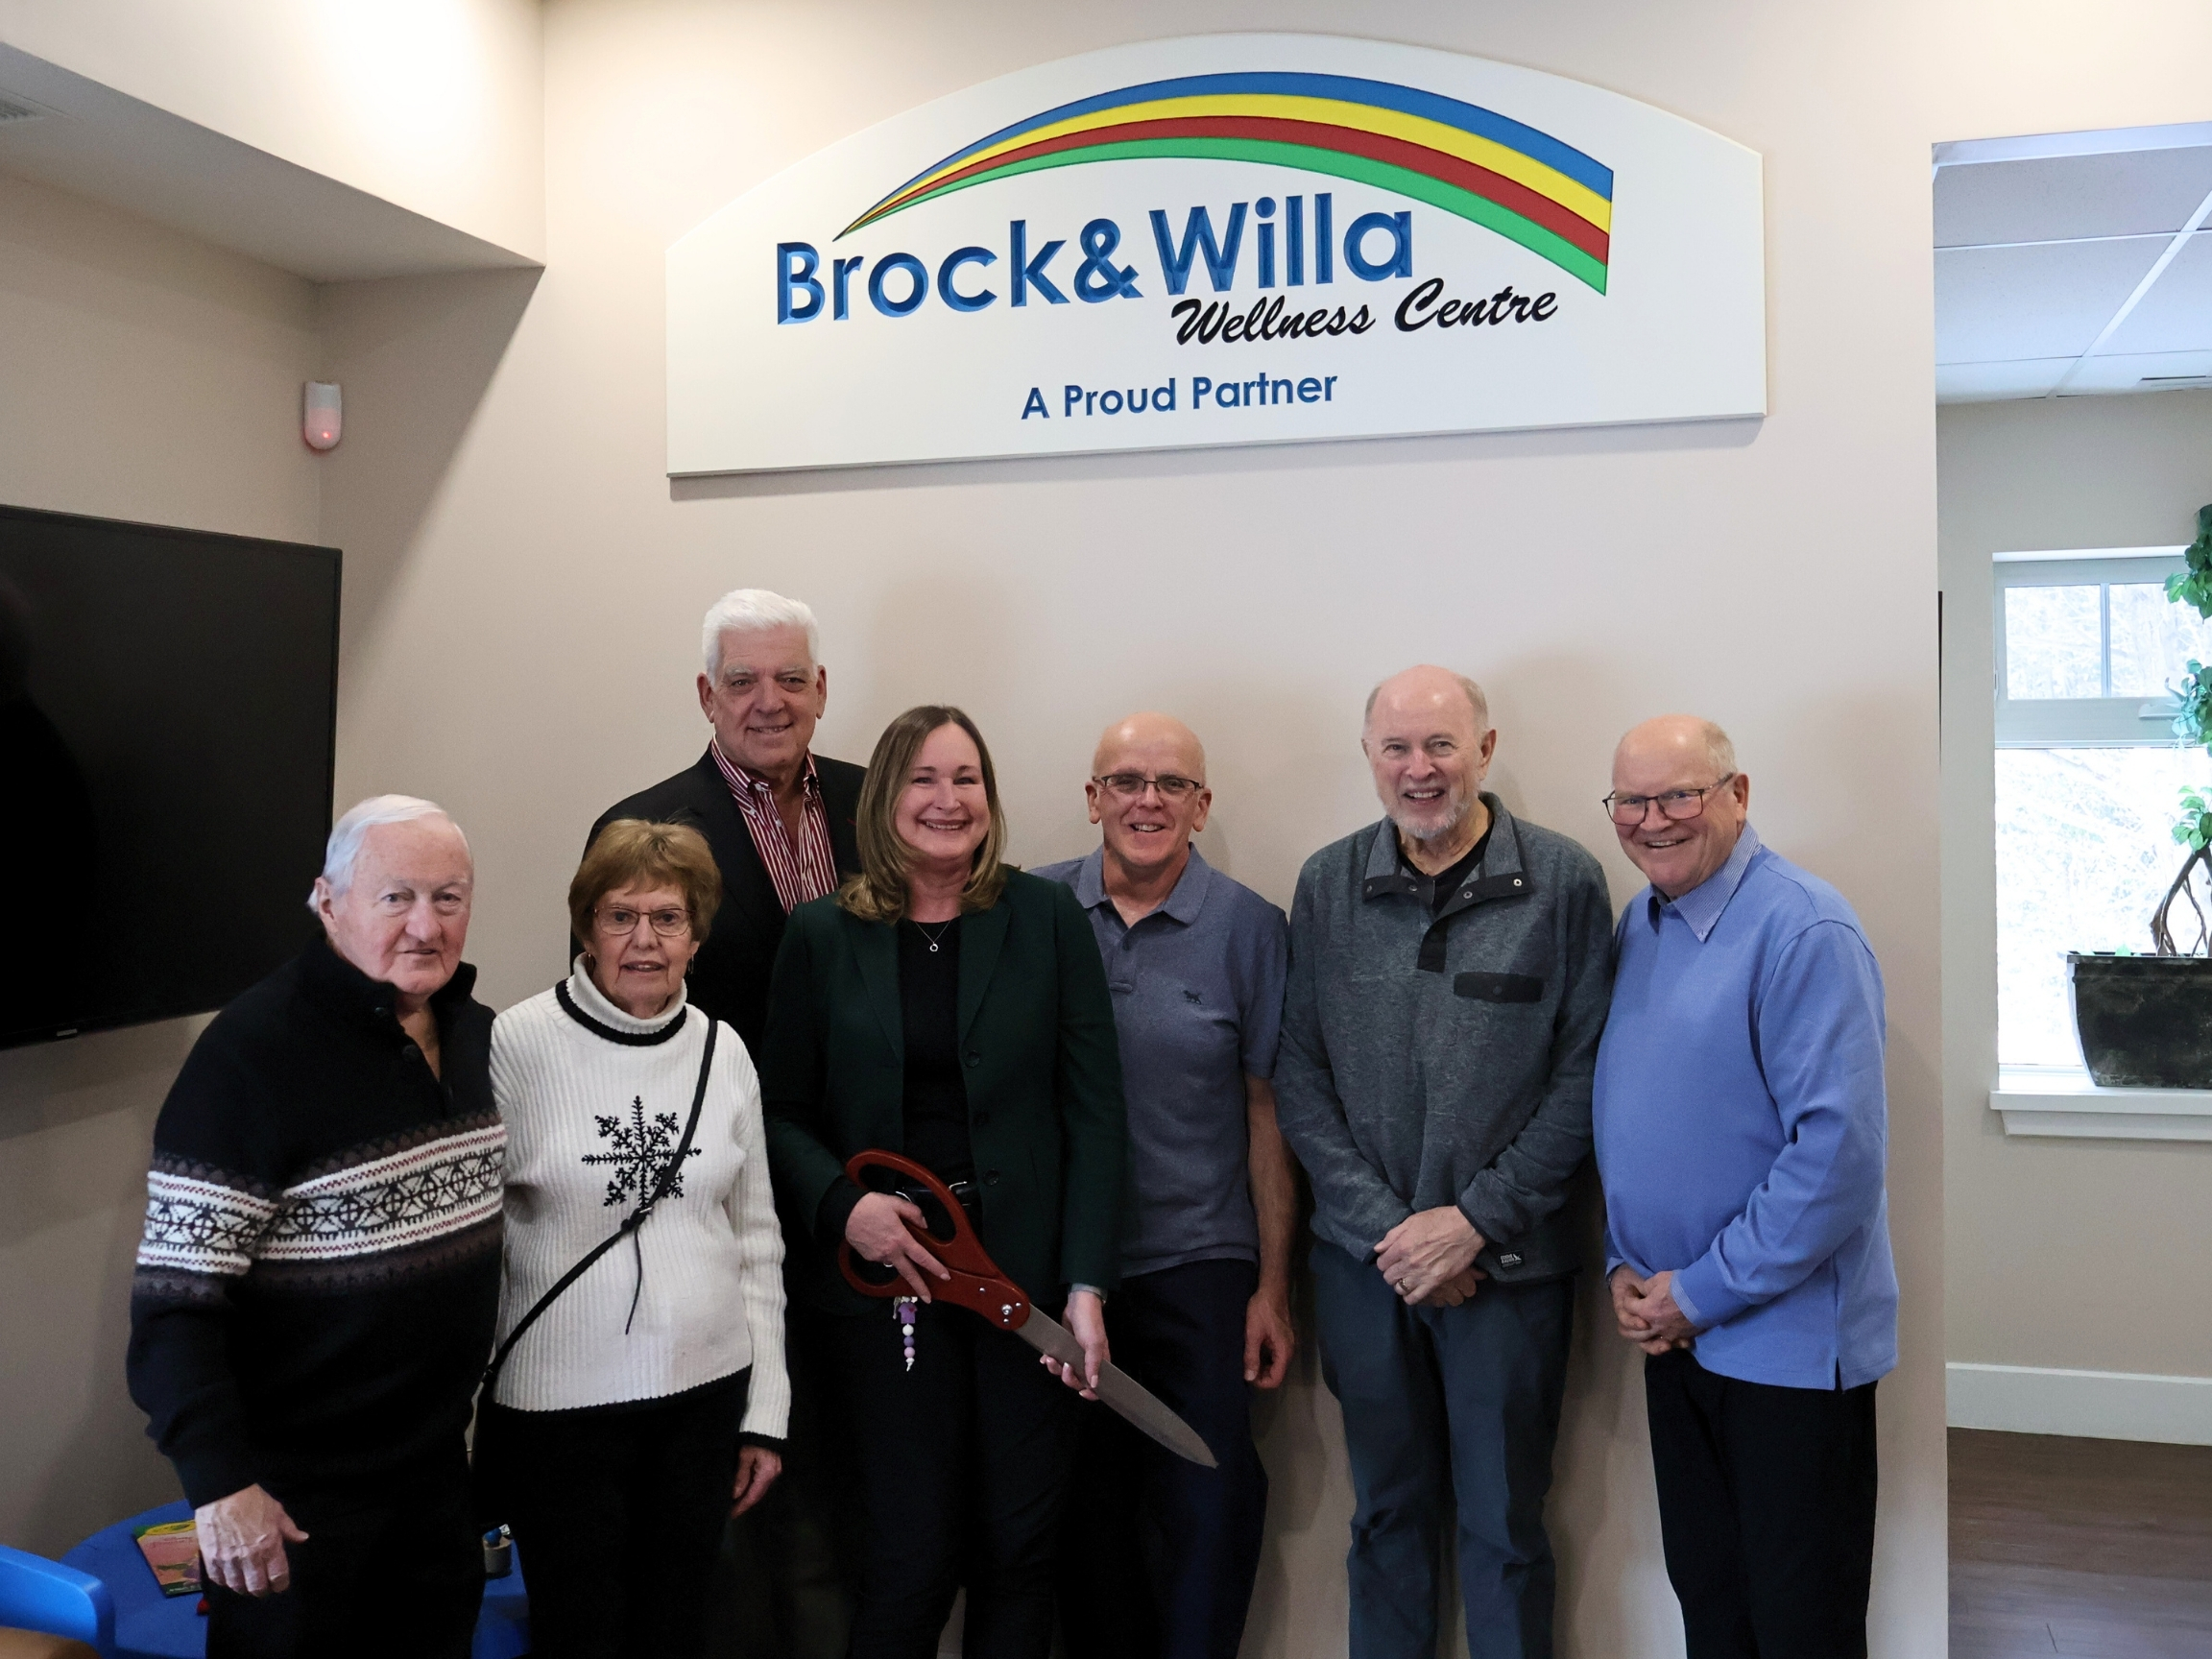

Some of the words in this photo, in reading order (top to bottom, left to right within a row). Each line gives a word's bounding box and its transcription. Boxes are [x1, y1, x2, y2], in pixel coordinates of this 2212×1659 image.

[1170, 294, 1377, 346] Wellness
[1394, 277, 1558, 333] Centre
[1021, 387, 1050, 420] A
[1064, 377, 1176, 417] Proud
[1192, 372, 1338, 410] Partner
